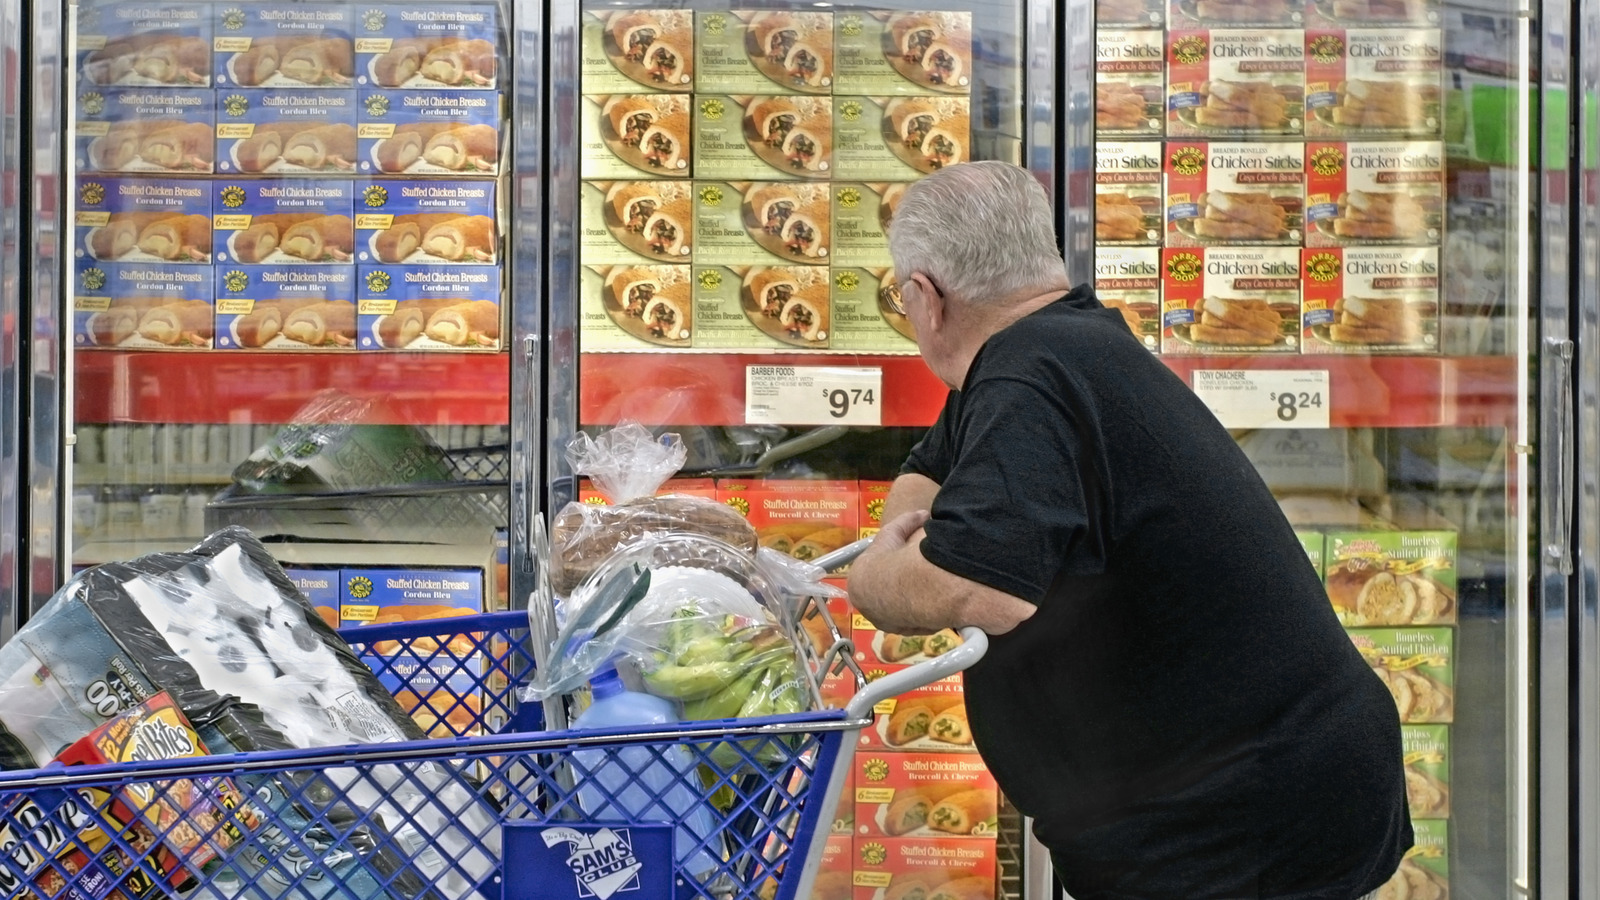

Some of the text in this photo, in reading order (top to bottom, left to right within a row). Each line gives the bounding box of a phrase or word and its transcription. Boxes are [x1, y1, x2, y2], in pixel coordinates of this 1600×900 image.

[260, 11, 343, 20] Stuffed Chicken Breasts
[401, 12, 483, 21] Stuffed Chicken Breasts
[1124, 44, 1160, 57] Sticks
[1213, 44, 1302, 57] Chicken Sticks
[1350, 44, 1438, 57] Chicken Sticks
[119, 95, 201, 105] Stuffed Chicken Breasts
[263, 96, 345, 106] Stuffed Chicken Breasts
[404, 97, 486, 106] Stuffed Chicken Breasts
[1122, 156, 1158, 168] Sticks
[1211, 156, 1301, 169] Chicken Sticks
[1350, 156, 1439, 168] Chicken Sticks
[119, 186, 201, 196] Stuffed Chicken Breasts
[260, 188, 342, 197] Stuffed Chicken Breasts
[402, 188, 484, 197] Stuffed Chicken Breasts
[1167, 253, 1202, 267] BARBER
[1306, 253, 1340, 268] BARBER
[1120, 262, 1156, 274] Sticks
[1208, 261, 1297, 275] Chicken Sticks
[1347, 261, 1435, 274] Chicken Sticks
[120, 272, 201, 281] Stuffed Chicken Breasts
[263, 273, 345, 282] Stuffed Chicken Breasts
[405, 273, 488, 283] Stuffed Chicken Breasts
[1170, 272, 1199, 282] FOODS
[1309, 272, 1338, 282] FOODS
[1168, 301, 1185, 310] Now!
[835, 313, 858, 321] Chicken
[776, 368, 794, 376] FOODS
[764, 499, 846, 510] Stuffed Chicken Breasts
[1402, 536, 1439, 546] Boneless
[302, 579, 327, 588] Breasts
[387, 579, 469, 590] Stuffed Chicken Breasts
[1395, 632, 1435, 642] Boneless
[1382, 645, 1448, 654] Stuffed Chicken
[142, 716, 194, 760] Bites
[903, 761, 987, 771] Stuffed Chicken Breasts
[901, 847, 984, 858] Stuffed Chicken Breasts
[570, 841, 630, 875] SAM'S
[584, 857, 636, 882] CLUB
